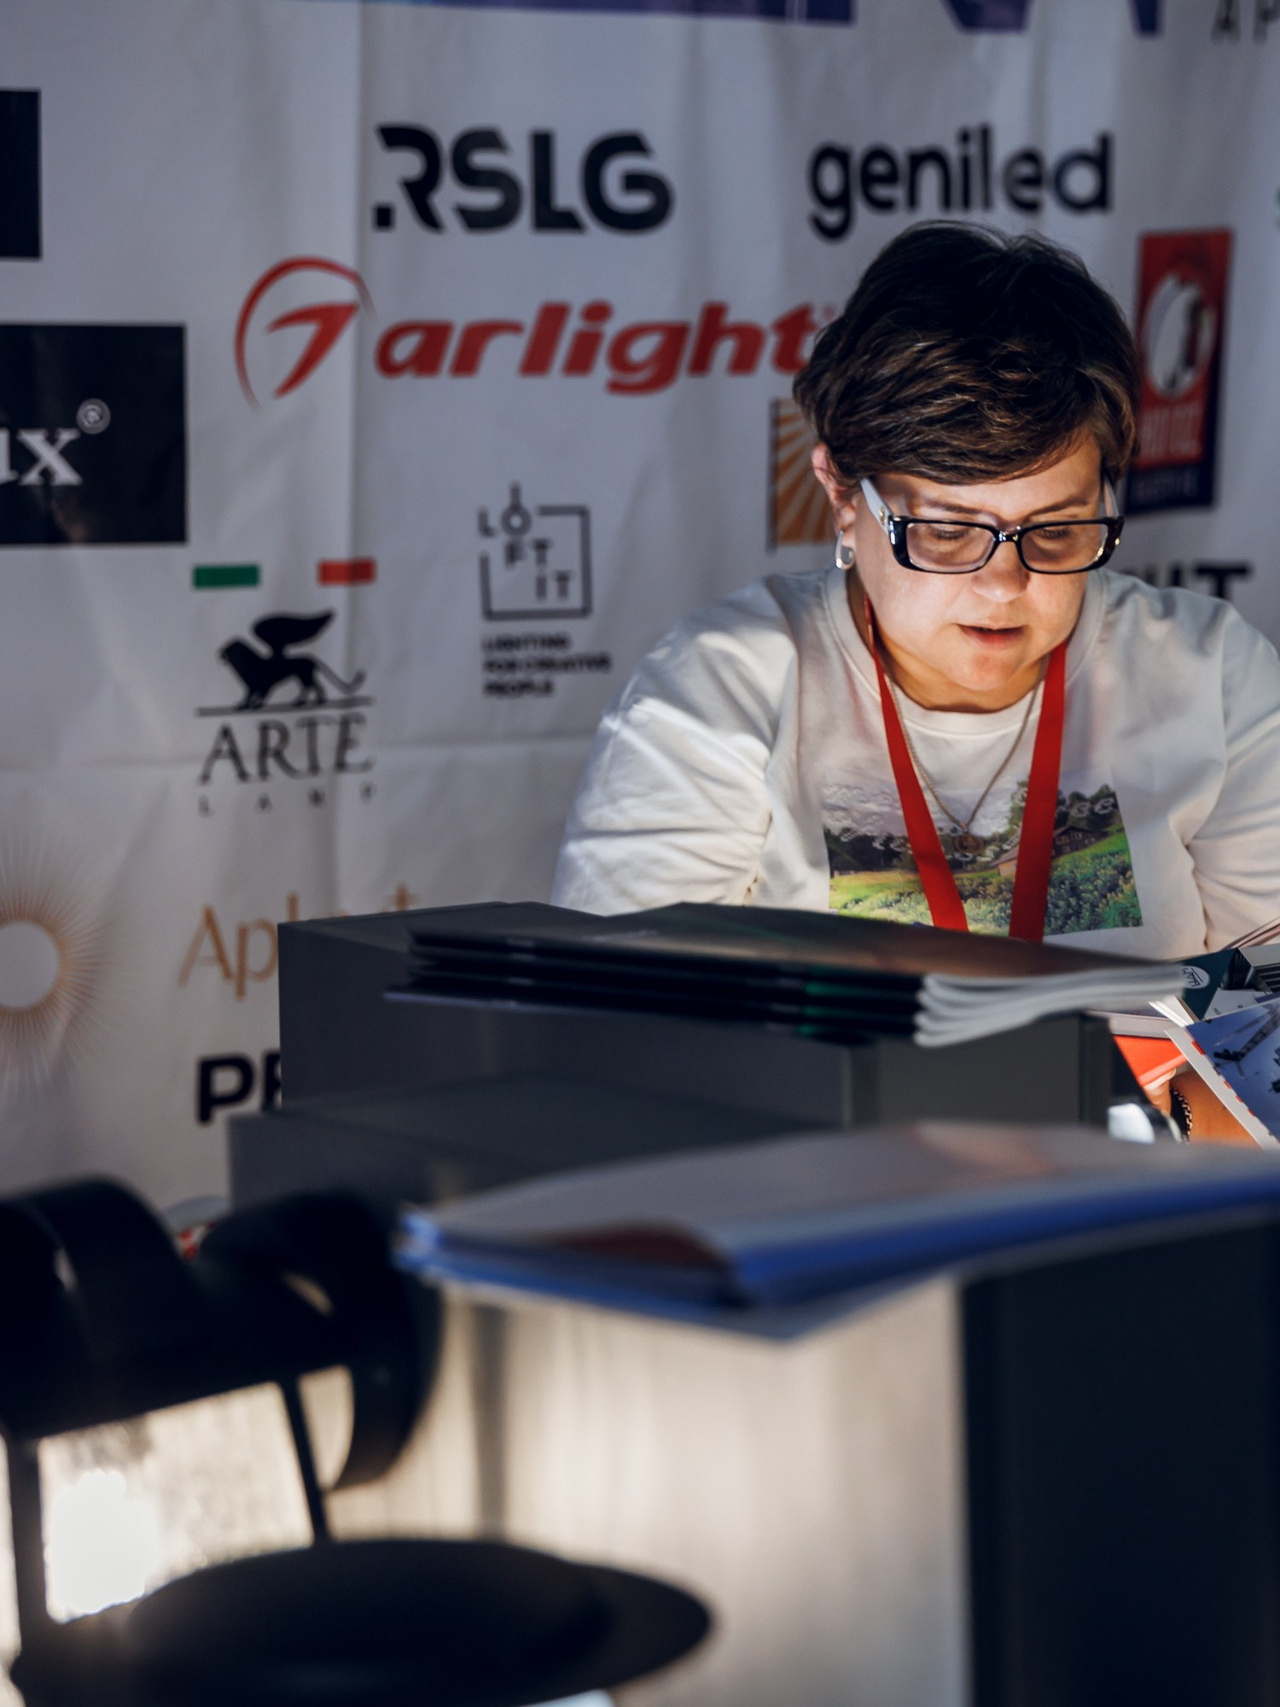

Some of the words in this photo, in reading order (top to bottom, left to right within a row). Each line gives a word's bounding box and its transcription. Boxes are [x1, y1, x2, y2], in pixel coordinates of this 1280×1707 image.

[808, 124, 1113, 241] geniled
[374, 299, 818, 397] arlight
[198, 712, 377, 785] ARTE
